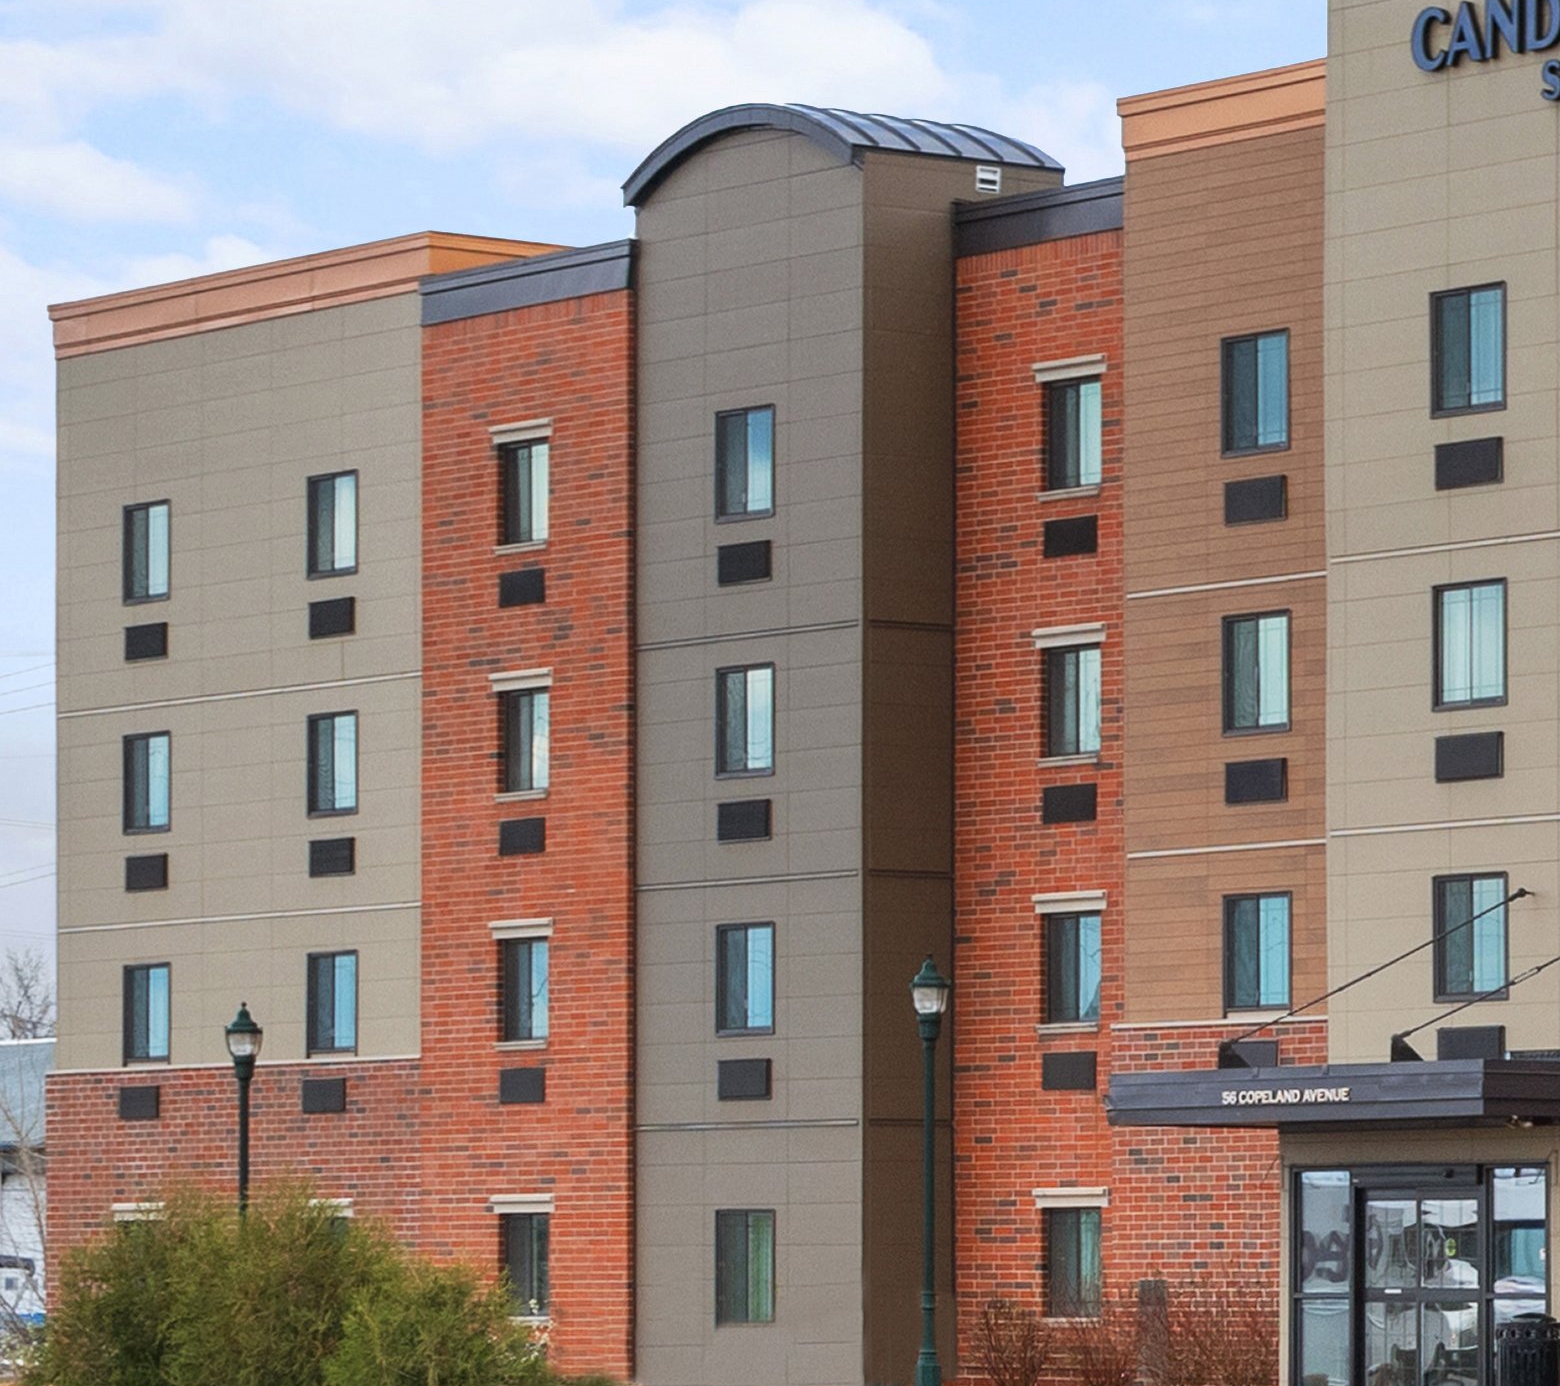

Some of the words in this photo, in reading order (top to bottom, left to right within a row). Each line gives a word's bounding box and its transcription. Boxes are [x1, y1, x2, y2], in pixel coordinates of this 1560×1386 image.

[1221, 1091, 1237, 1105] 56
[1238, 1089, 1301, 1104] COPELAND
[1302, 1088, 1350, 1102] AVENUE
